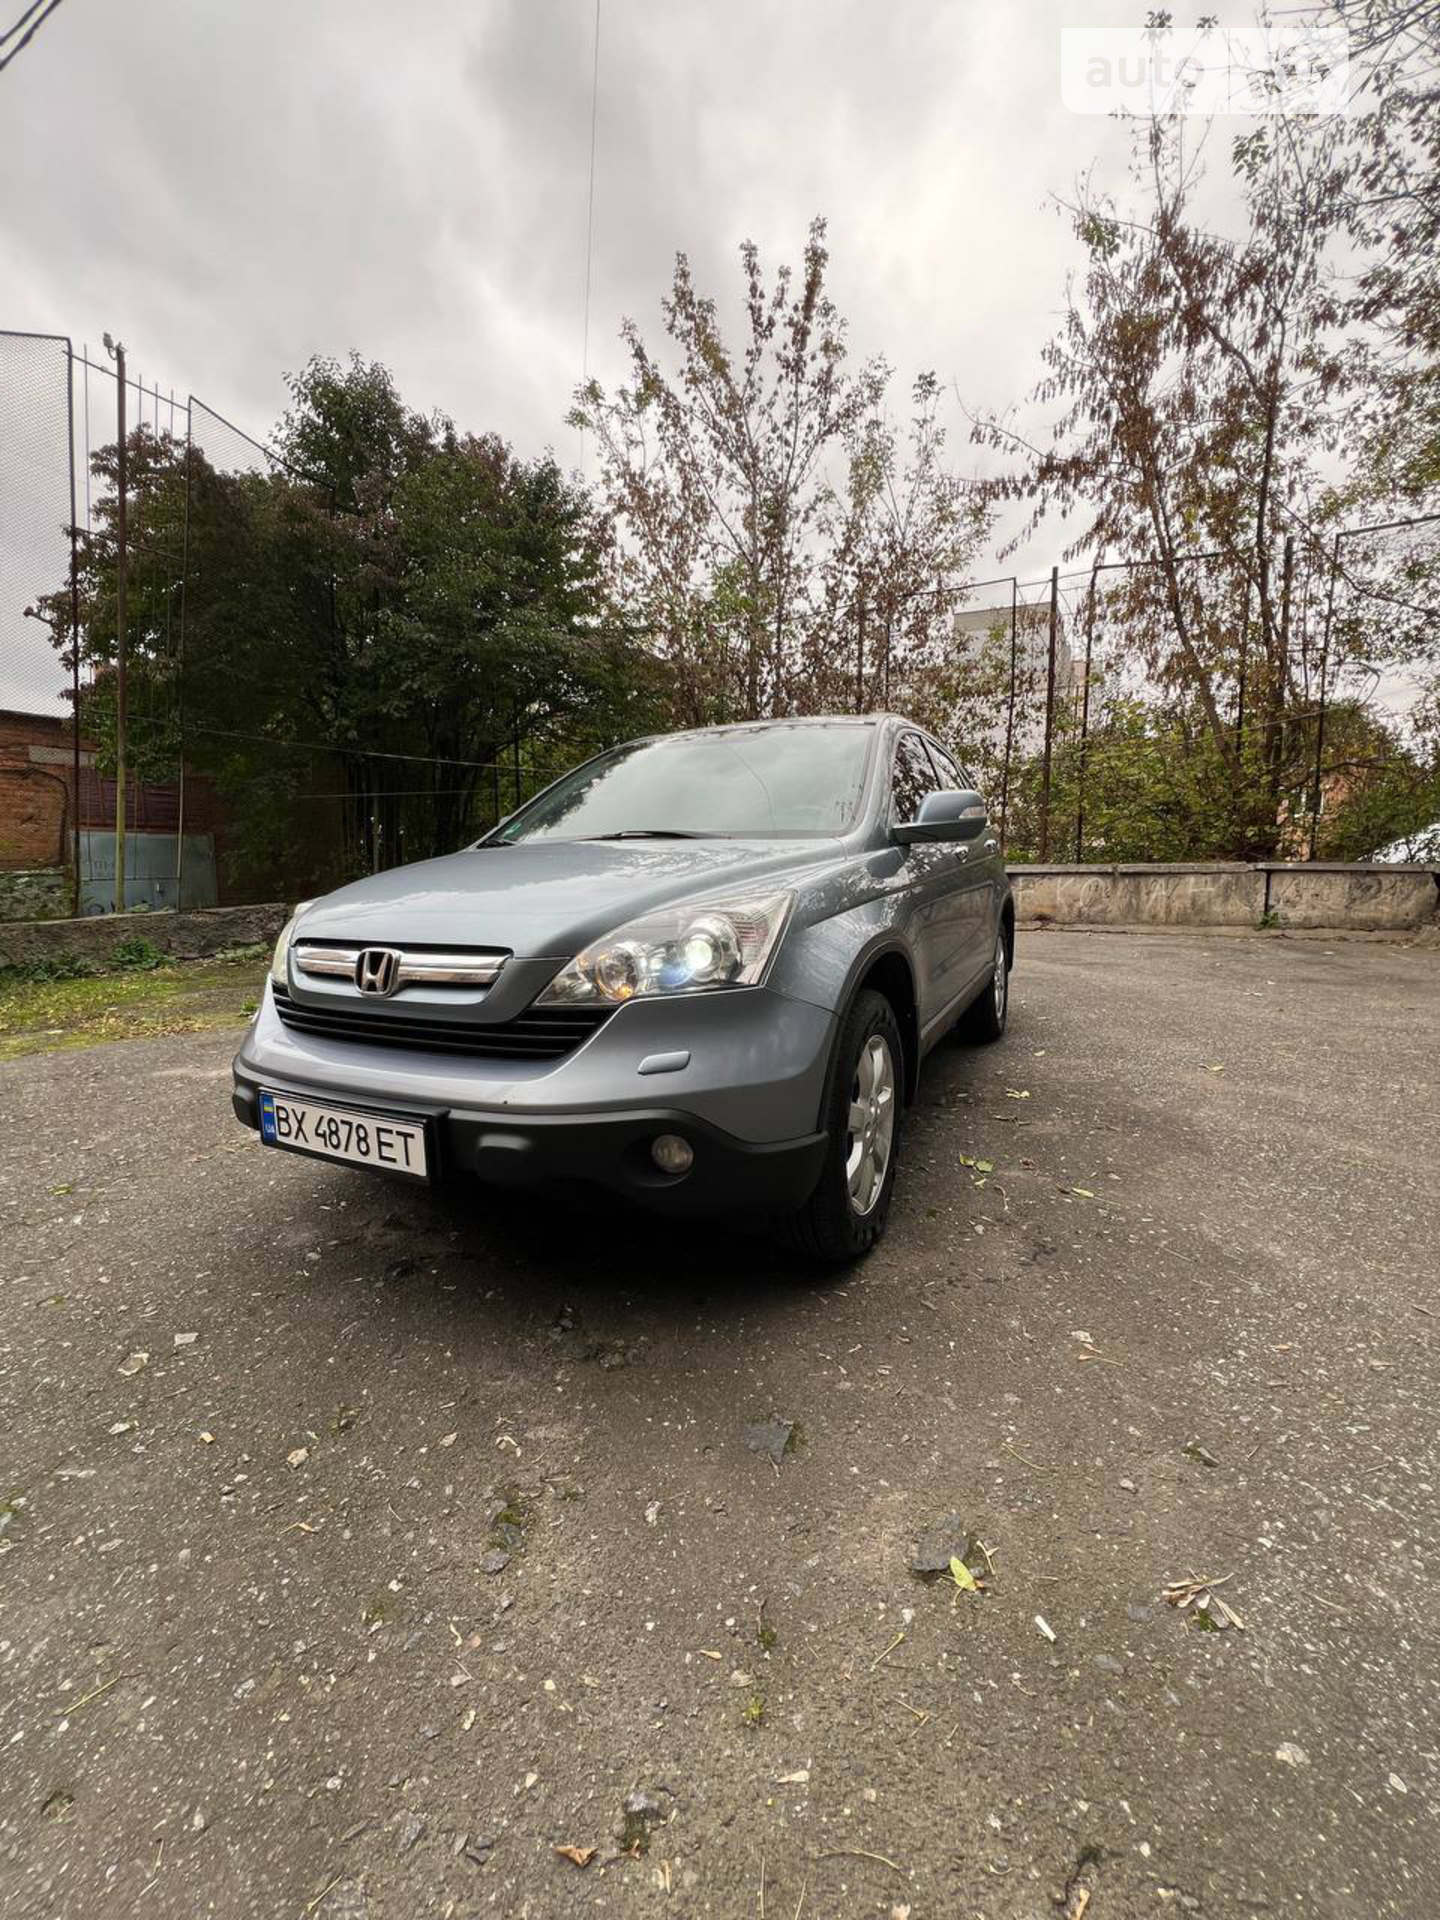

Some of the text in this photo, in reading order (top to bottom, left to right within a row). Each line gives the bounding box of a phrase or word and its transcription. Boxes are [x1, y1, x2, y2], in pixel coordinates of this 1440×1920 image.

[276, 1105, 415, 1167] BX 4878 ET
